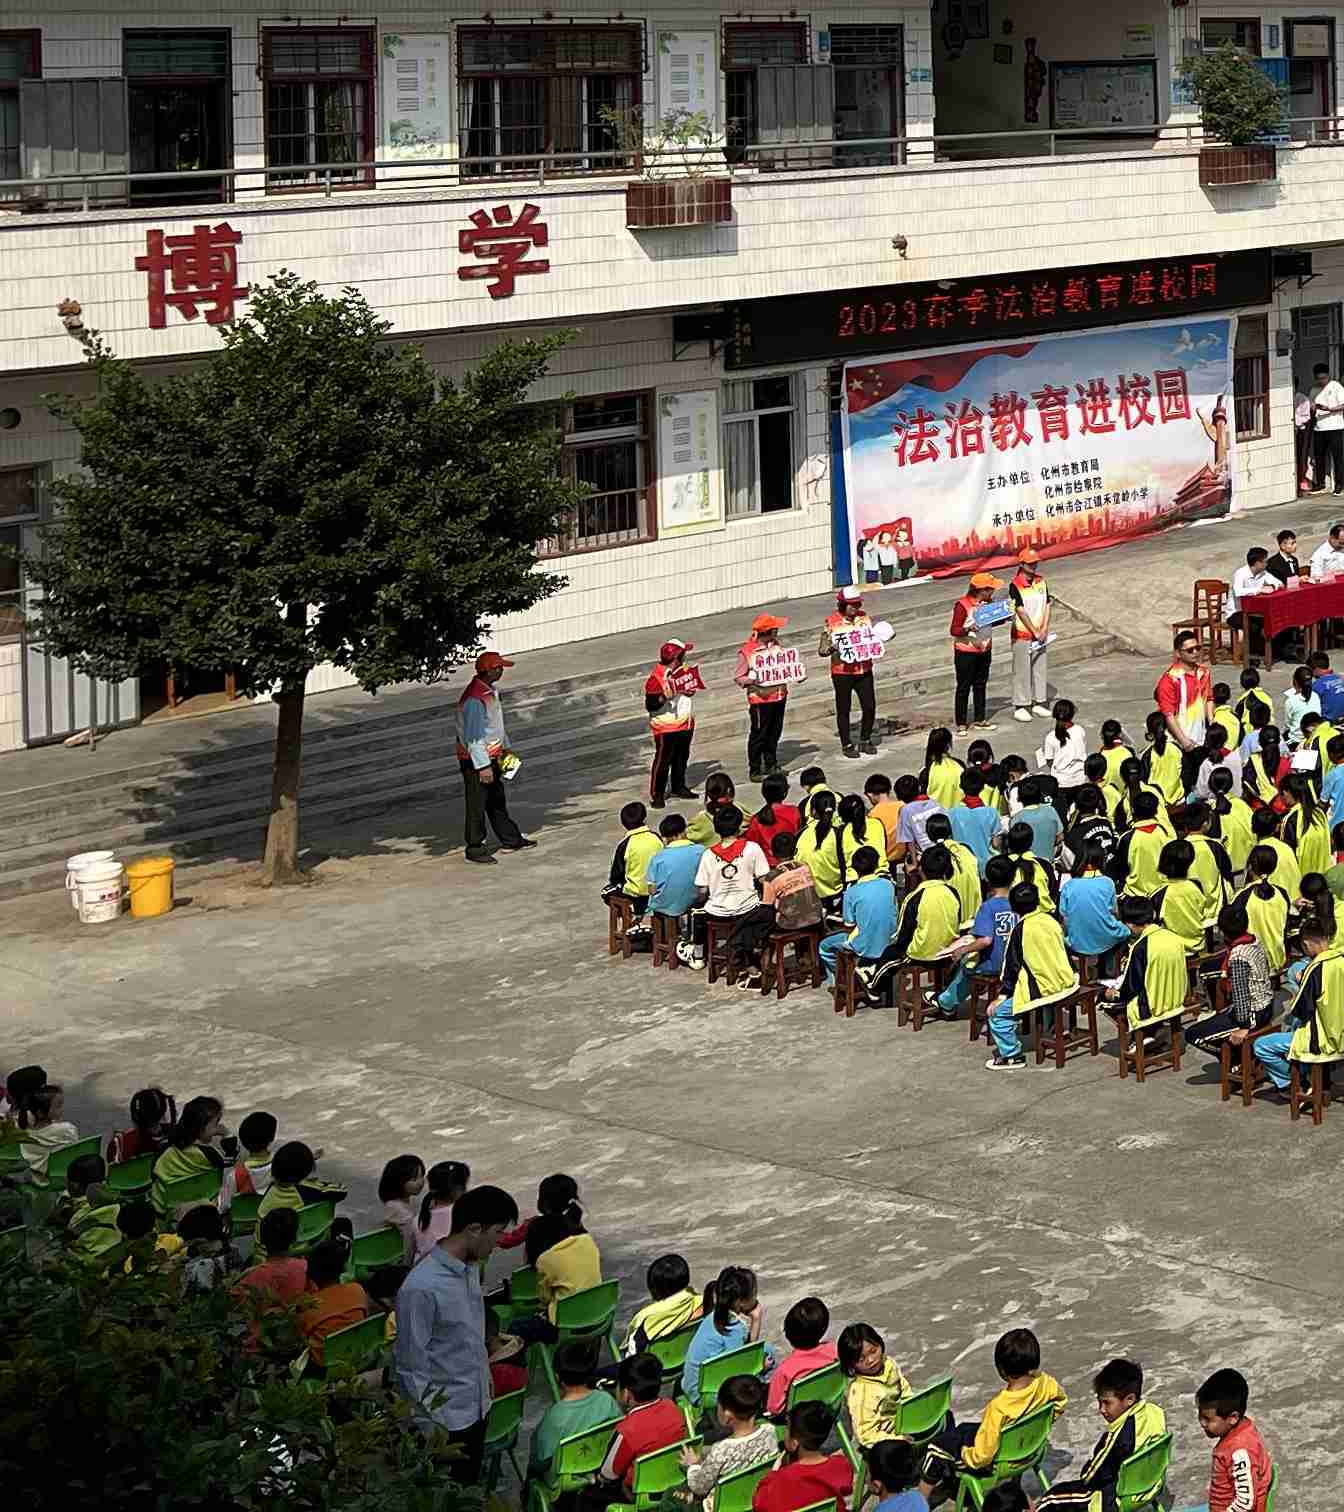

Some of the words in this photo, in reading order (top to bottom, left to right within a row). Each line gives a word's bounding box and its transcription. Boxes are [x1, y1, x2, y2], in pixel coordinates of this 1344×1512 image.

[891, 366, 1193, 468] 法治教育进校园
[1040, 458, 1100, 481] 化州市教育局
[1045, 477, 1103, 499] 化州市检察院
